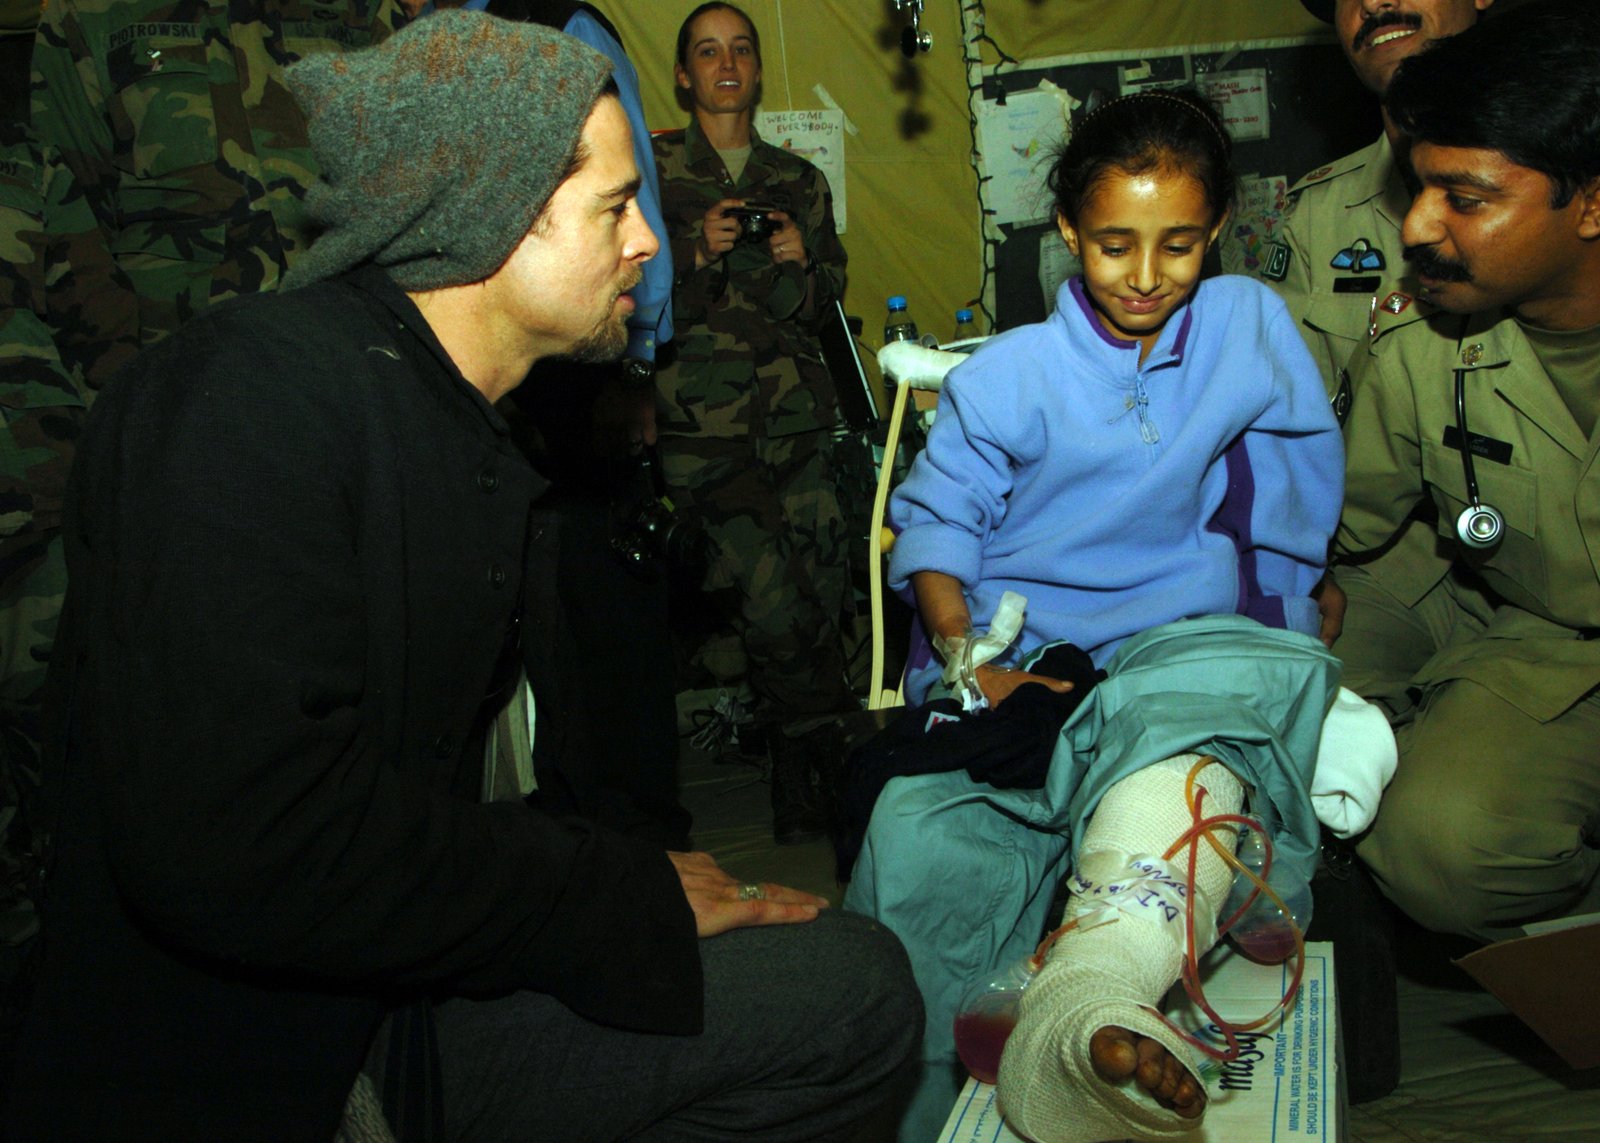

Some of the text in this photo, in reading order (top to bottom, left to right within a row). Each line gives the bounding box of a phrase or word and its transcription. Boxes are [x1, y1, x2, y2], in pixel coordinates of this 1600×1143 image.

[110, 24, 196, 48] PIOTROWSKI
[766, 112, 823, 124] WELCOME
[1293, 1020, 1303, 1051] DRINKING
[1274, 1032, 1287, 1077] IMPORTANT
[1293, 1051, 1302, 1065] FOR
[1306, 979, 1319, 1135] SHOULD BE KEPT UNDER HYGIENIC CONDITIONS
[1290, 1074, 1301, 1098] WATER
[1288, 1099, 1301, 1131] MINERAL
